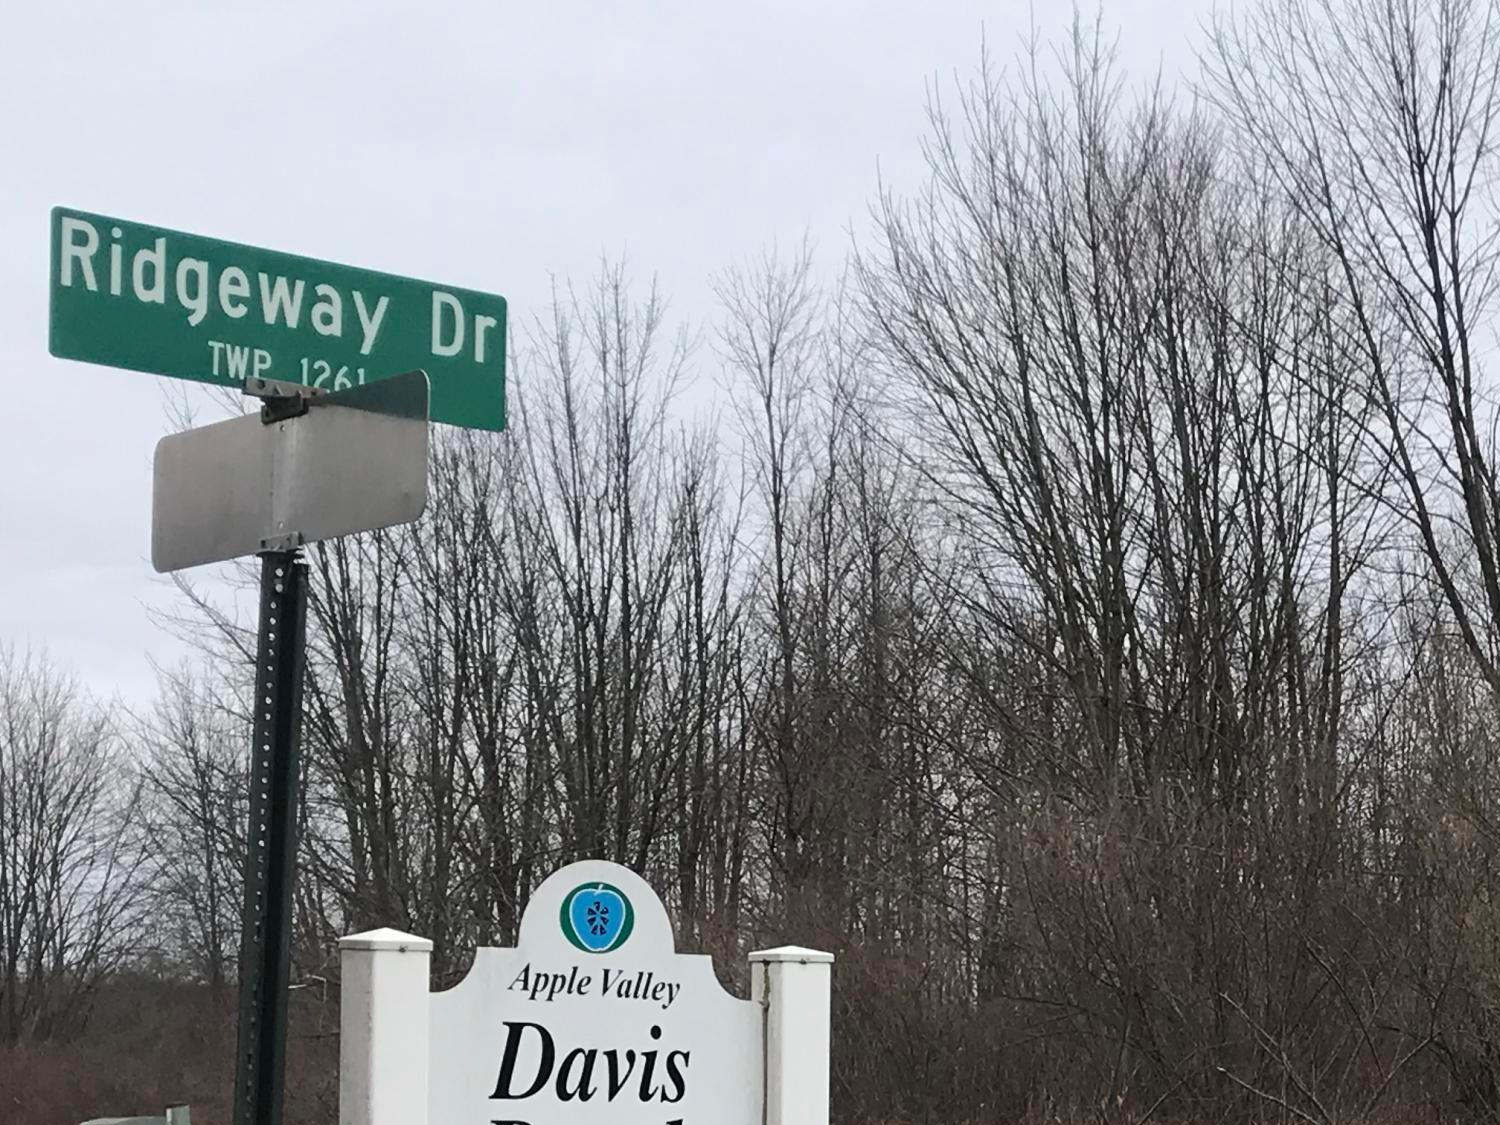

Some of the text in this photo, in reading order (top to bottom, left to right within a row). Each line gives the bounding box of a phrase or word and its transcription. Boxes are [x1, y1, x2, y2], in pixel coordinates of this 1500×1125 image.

[60, 216, 497, 363] Ridgeway Dr
[207, 340, 272, 380] TWP
[507, 962, 681, 1010] Apple Valley
[487, 1021, 691, 1104] Davis
